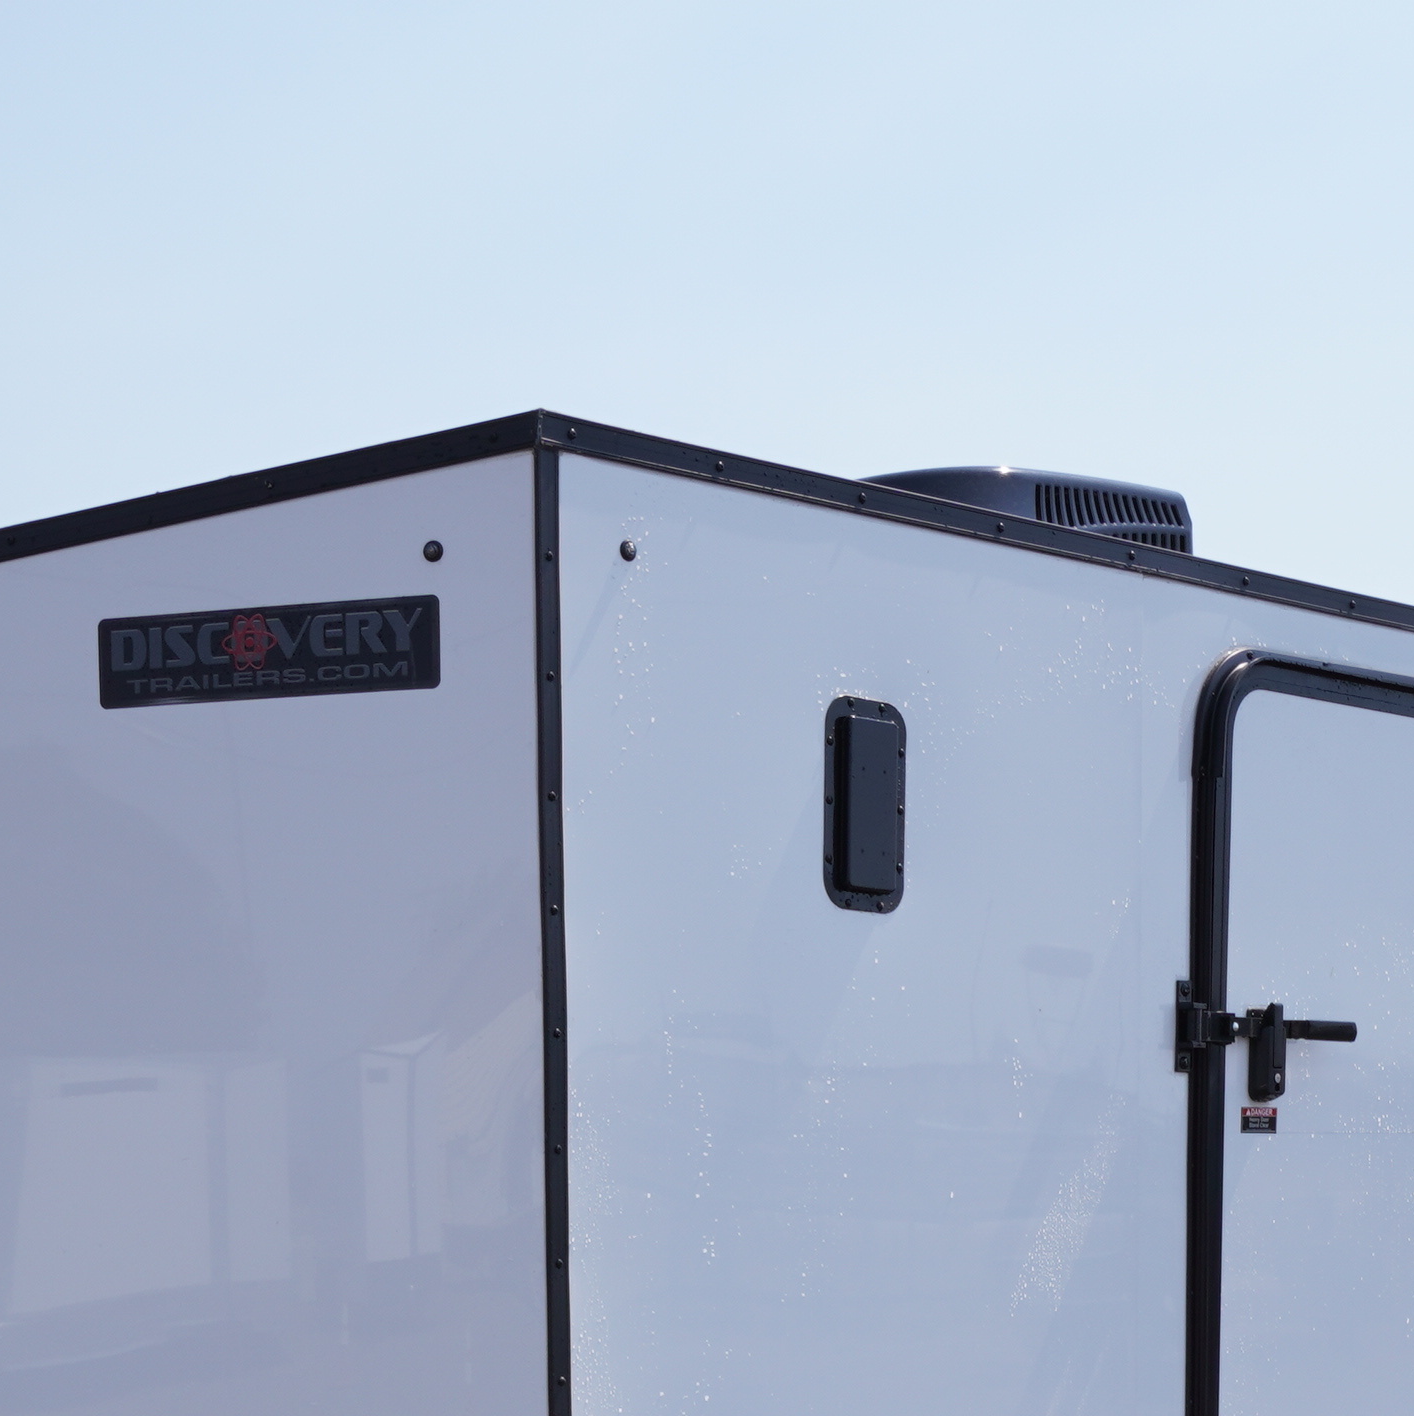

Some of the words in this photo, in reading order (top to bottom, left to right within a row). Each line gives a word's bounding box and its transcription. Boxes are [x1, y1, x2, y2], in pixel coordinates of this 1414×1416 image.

[110, 607, 423, 672] DISCOVERY
[126, 661, 409, 694] TRAILERS.COM
[1251, 1107, 1274, 1116] DANGER
